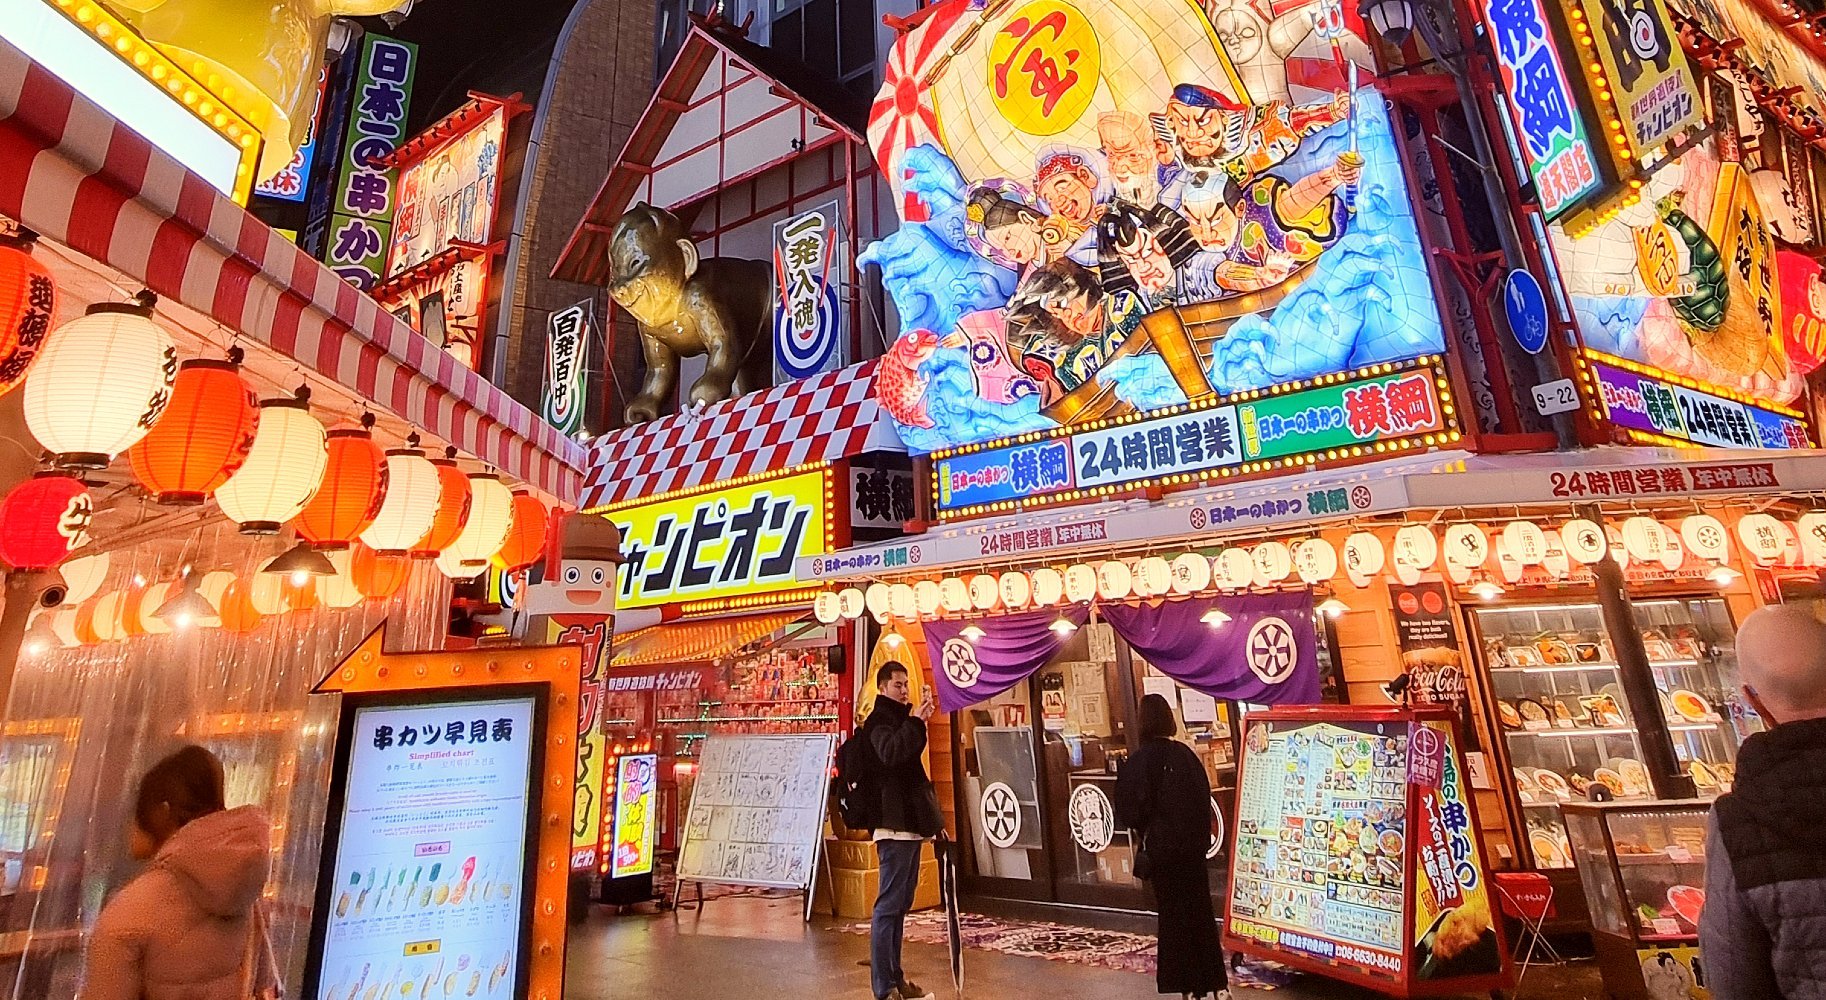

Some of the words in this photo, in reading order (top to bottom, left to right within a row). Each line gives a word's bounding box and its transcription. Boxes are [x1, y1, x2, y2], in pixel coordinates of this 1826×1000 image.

[993, 10, 1082, 118] 宝
[1636, 92, 1692, 145] チャンピオン
[786, 216, 821, 329] 一発入魂
[554, 310, 580, 403] 百発百中
[1259, 408, 1344, 440] 日本一の串かつ
[1345, 376, 1434, 436] 横綱
[1537, 386, 1574, 409] 9-22
[1680, 395, 1755, 447] 24時間営業
[951, 466, 1009, 491] 日本一の串かつ
[1011, 444, 1068, 491] 横綱
[1080, 415, 1235, 480] 24時間営業
[1550, 467, 1688, 497] 24時間営業
[1696, 466, 1775, 488] 年中無休
[1209, 498, 1302, 524] 日本一の串かつ
[1306, 487, 1350, 515] 横綱
[616, 495, 812, 597] ャンピオン
[981, 528, 1053, 555] 24時間営業
[1057, 522, 1105, 543] 年中無休
[824, 554, 881, 573] 日本一の串かつ
[883, 547, 908, 568] 横綱
[656, 670, 703, 691] チャンピオン
[373, 717, 514, 751] 串カツ早見表
[409, 751, 451, 761] Simplified
[453, 749, 475, 757] chart
[1342, 948, 1401, 973] 06-6630-8440
